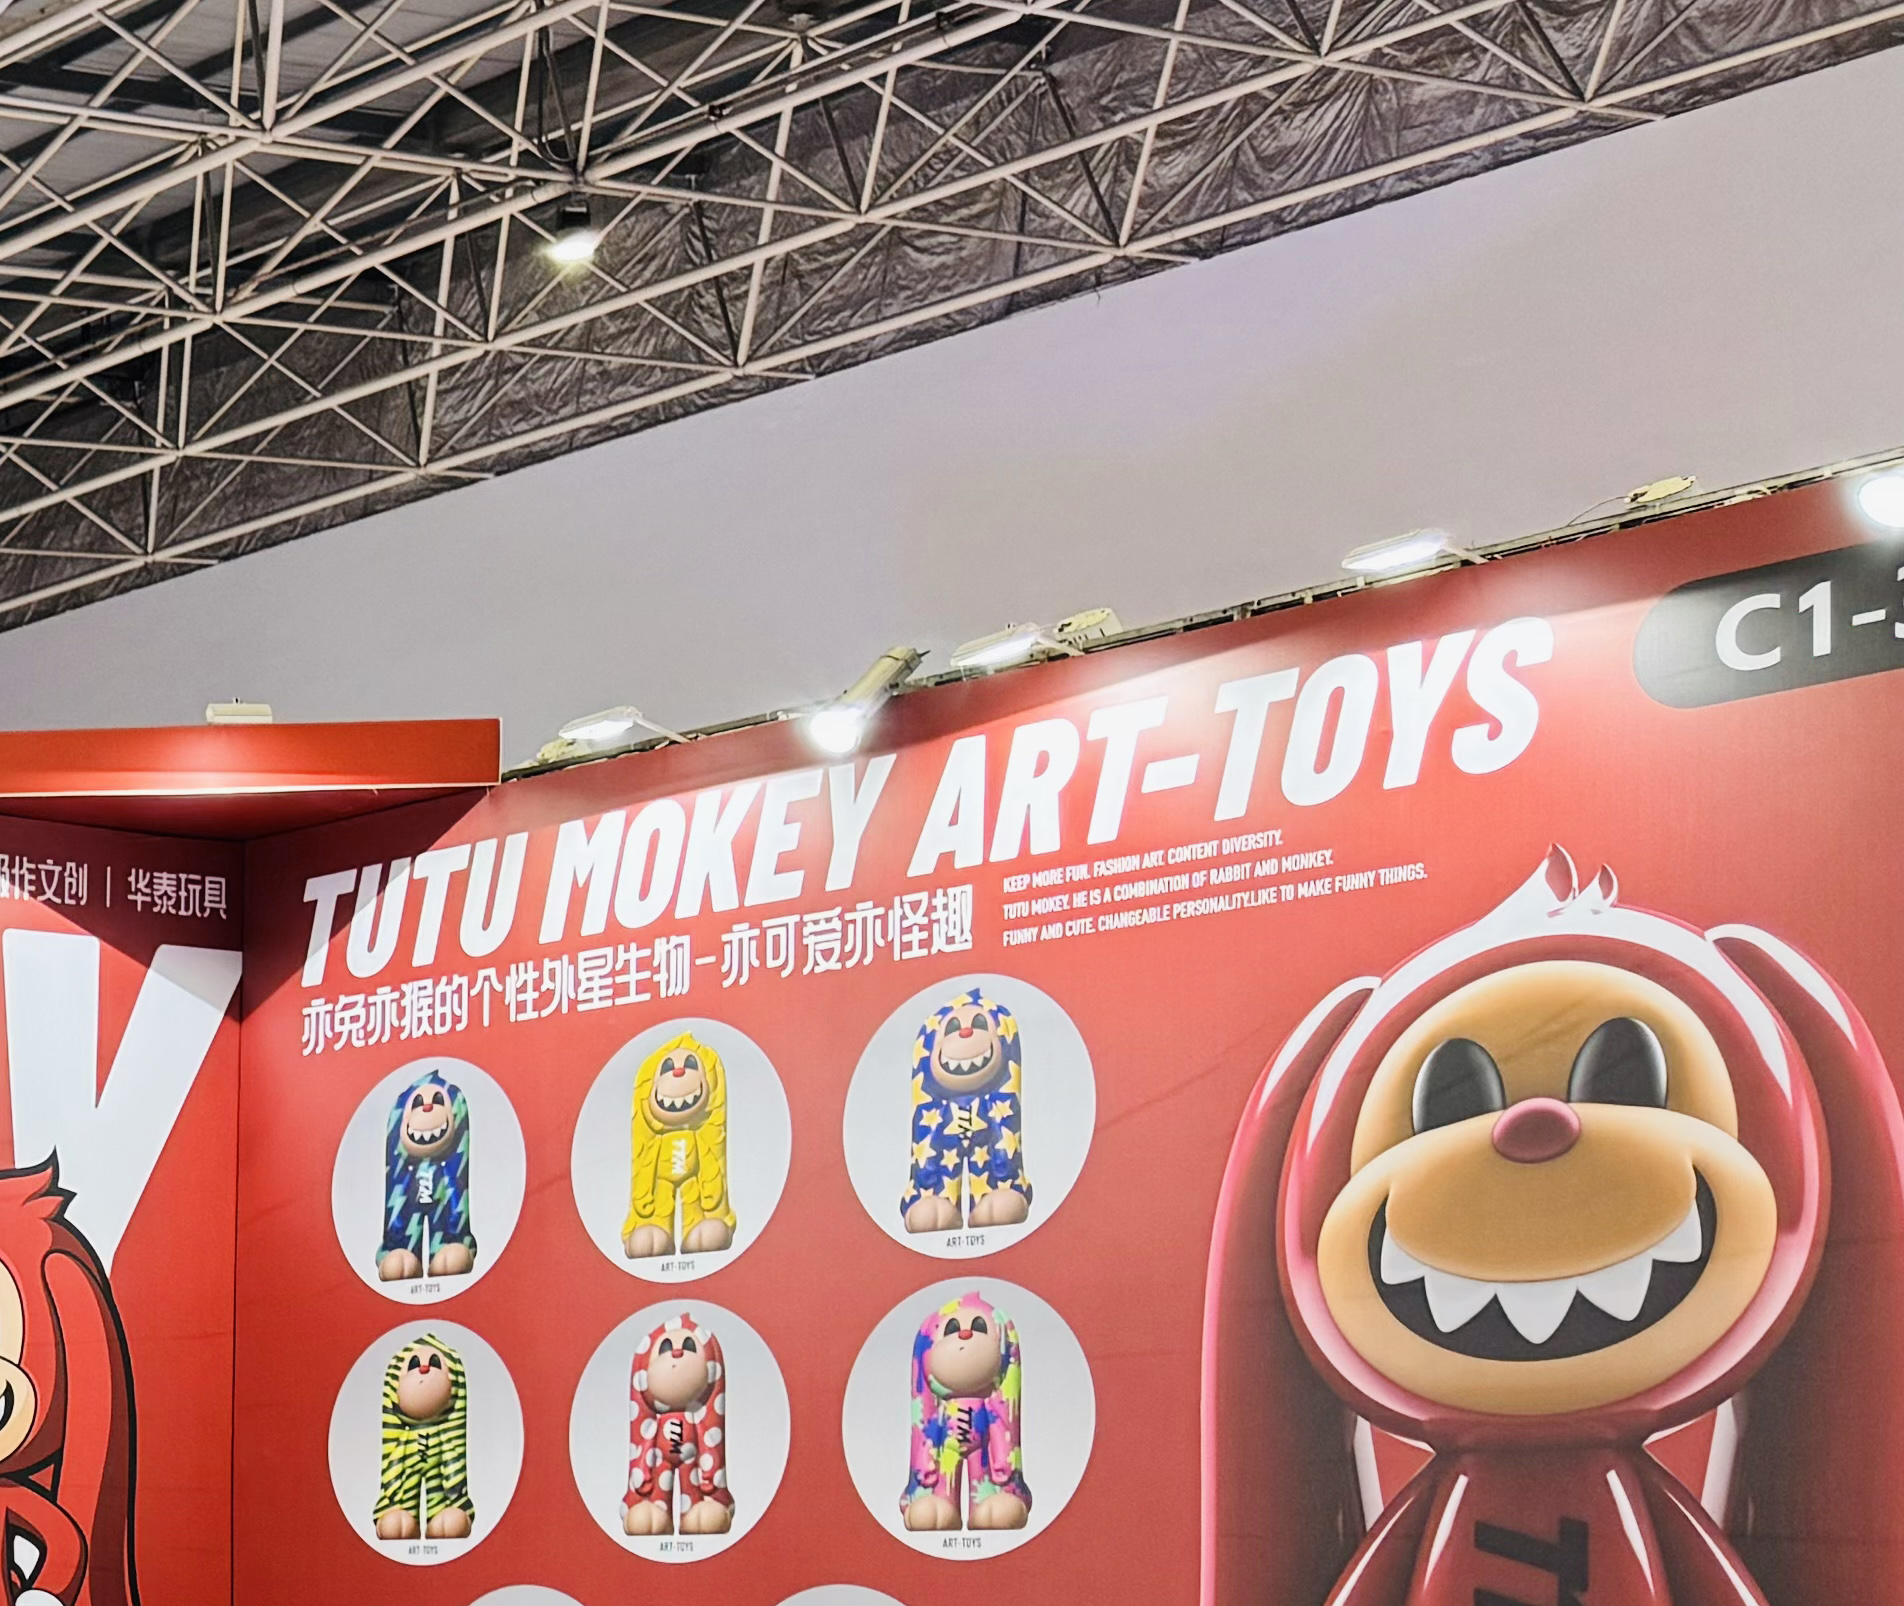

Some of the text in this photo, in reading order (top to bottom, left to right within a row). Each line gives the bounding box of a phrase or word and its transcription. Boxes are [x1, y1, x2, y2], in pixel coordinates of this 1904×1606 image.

[1714, 580, 1904, 672] C1-
[300, 615, 1554, 989] TUTU MOKEY ART-TOYS
[127, 872, 228, 919] 华泰玩具
[1003, 874, 1031, 894] KEEP
[1032, 868, 1064, 888] MORE
[1093, 854, 1141, 879] FASHION
[1168, 840, 1220, 866] CONTENT
[1222, 829, 1284, 860] DIVERSITY.
[1003, 900, 1030, 920] TUTU
[1072, 892, 1088, 909] HE
[1089, 889, 1102, 906] IS
[1102, 887, 1113, 904] A
[1113, 875, 1191, 903] COMBINATION
[1191, 870, 1208, 889] OF
[1209, 862, 1252, 885] RABBIT
[1254, 858, 1279, 878] AND
[1281, 849, 1334, 873] MONKEY.
[1003, 926, 1039, 947] FUNNY
[1040, 921, 1064, 941] AND
[1097, 905, 1171, 933] CHANGEABLE
[1279, 883, 1295, 902] TO
[1297, 876, 1334, 900] MAKE
[1335, 869, 1377, 893] FUNNY
[1379, 862, 1428, 887] THINGS.
